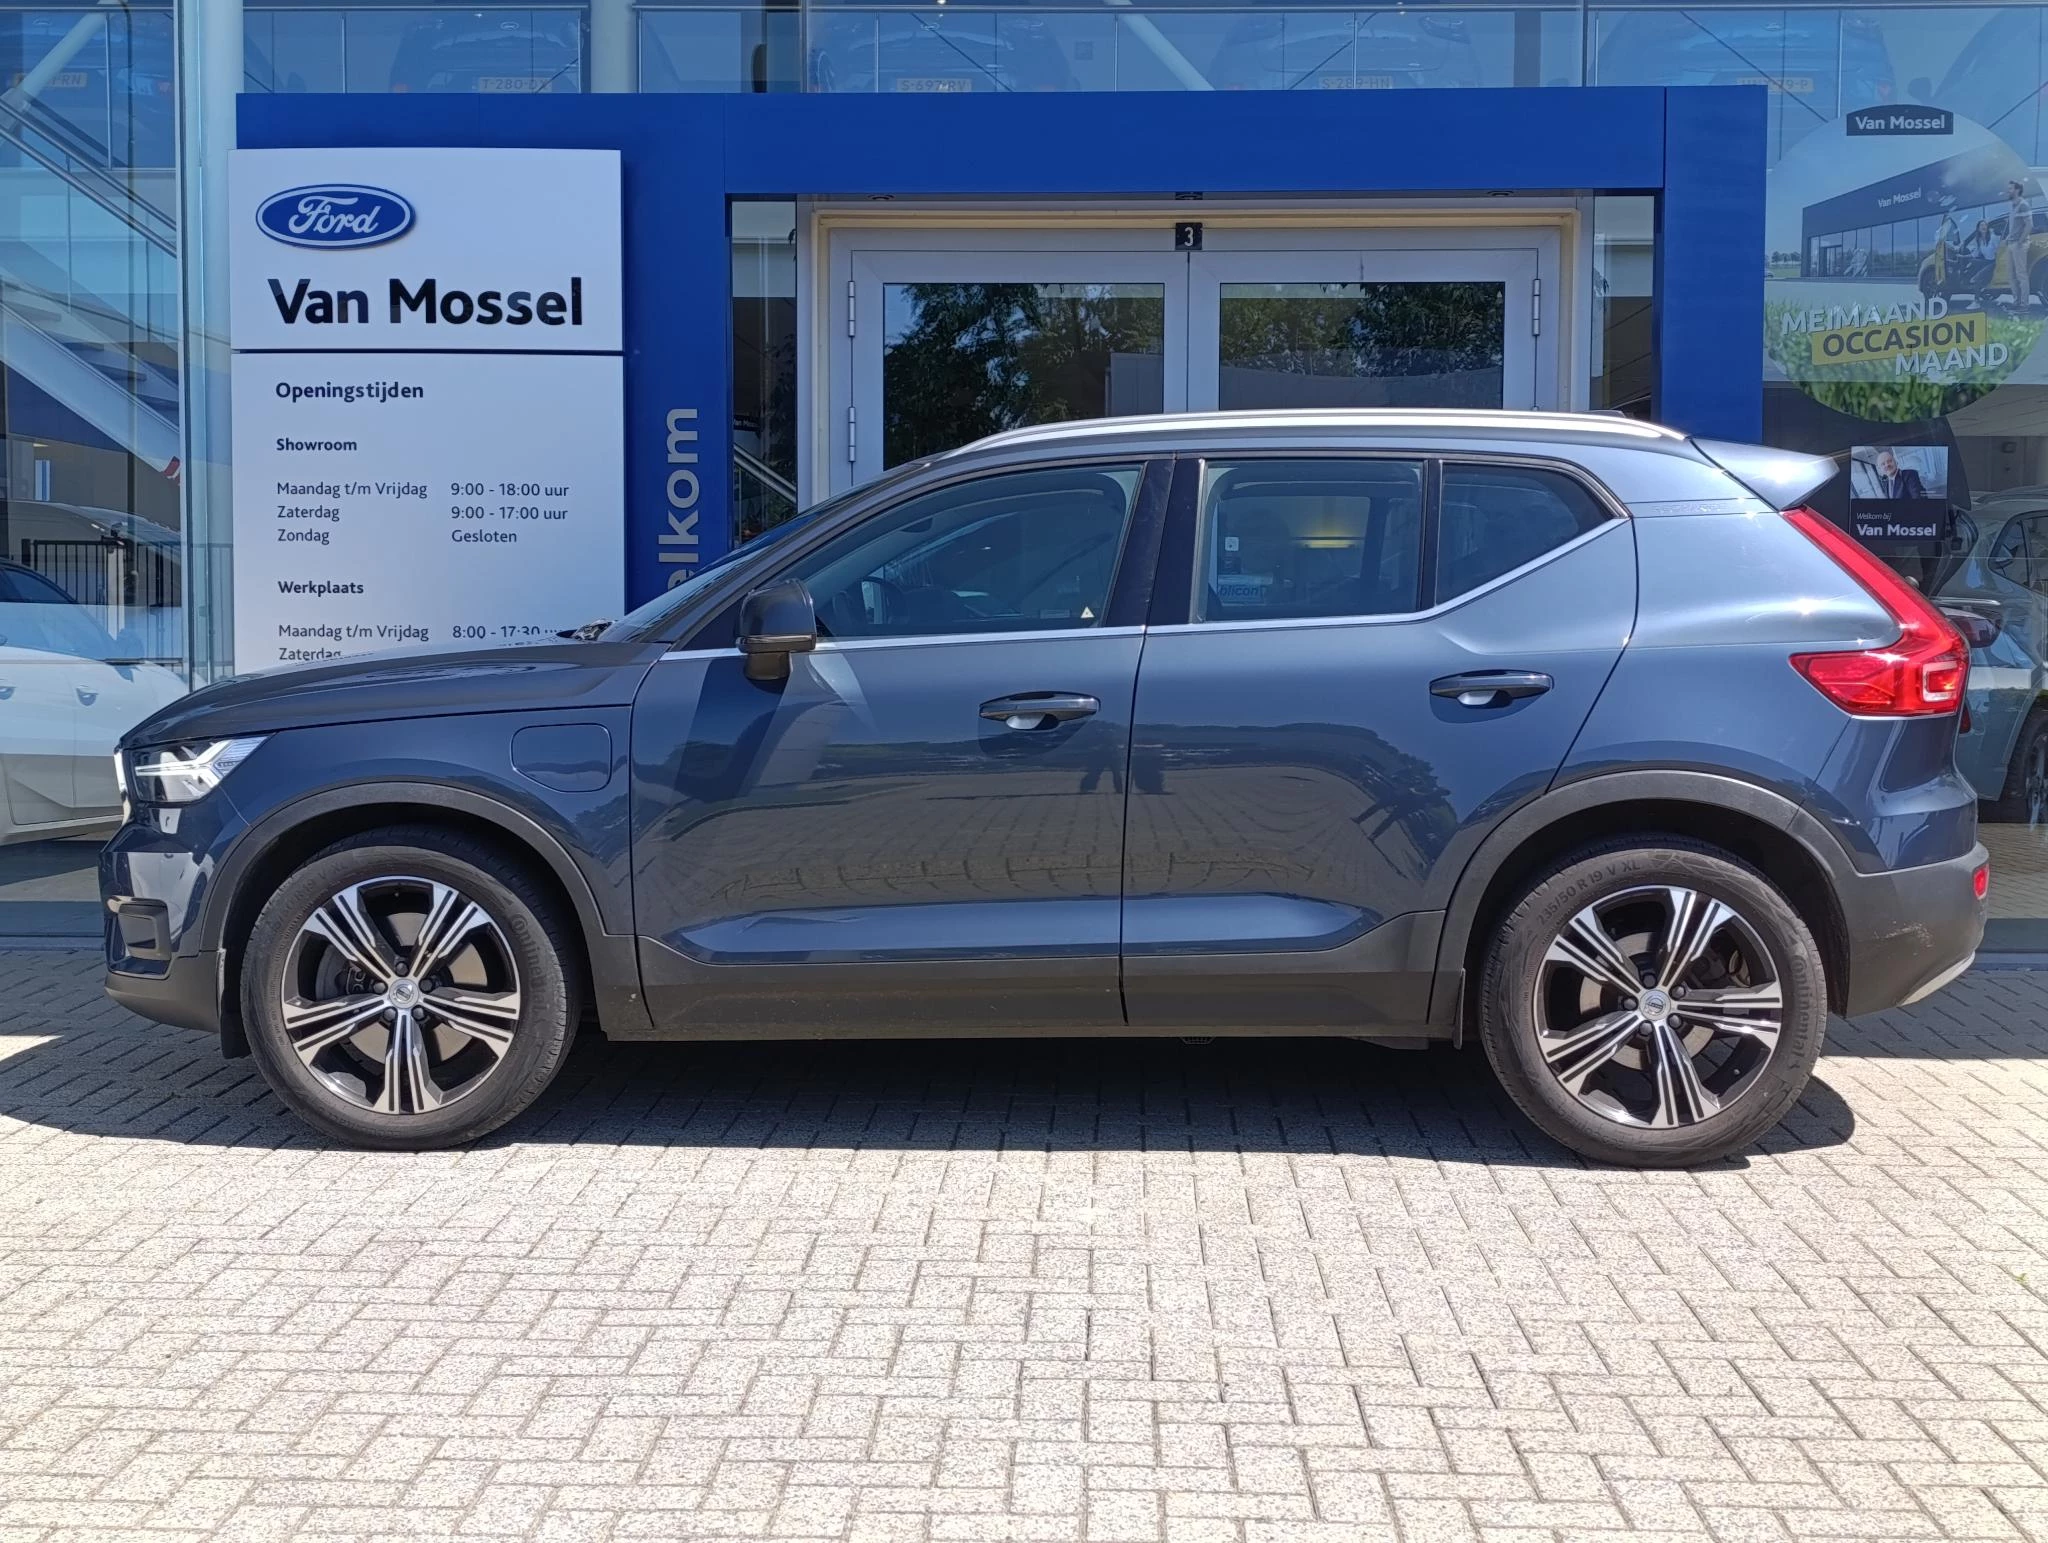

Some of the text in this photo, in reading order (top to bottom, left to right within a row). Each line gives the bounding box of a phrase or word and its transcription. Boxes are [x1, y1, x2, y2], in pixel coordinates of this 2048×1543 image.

[1855, 114, 1946, 130] Van Mossel
[288, 195, 381, 234] Ford
[1184, 226, 1194, 247] 3
[268, 276, 583, 326] Van Mossel
[1782, 298, 1949, 336] MEIMAAND
[1822, 319, 1976, 357] OCCASION
[1895, 343, 2010, 377] MAAND
[275, 381, 424, 403] Openingstijden
[276, 437, 357, 452] Showroom
[277, 481, 428, 499] Maandag t/m Vrijdag
[450, 482, 485, 497] 9:00
[498, 482, 541, 497] 18:00
[544, 486, 570, 497] uur
[277, 504, 340, 522] Zaterdag
[451, 505, 485, 520] 9:00
[499, 506, 540, 520] 17:00
[543, 510, 569, 521] uur
[1856, 512, 1882, 521] Welkom
[277, 528, 330, 546] Zondag
[451, 528, 517, 543] Gesloten
[1856, 522, 1937, 537] Van Mossel
[278, 580, 365, 598] Werkplaats
[278, 624, 430, 643] Maandag t/m Vrijdag
[452, 625, 486, 639] 8:00
[1577, 879, 1589, 891] R
[1588, 870, 1603, 884] 19
[1605, 864, 1617, 876] V
[1621, 860, 1641, 873] XL
